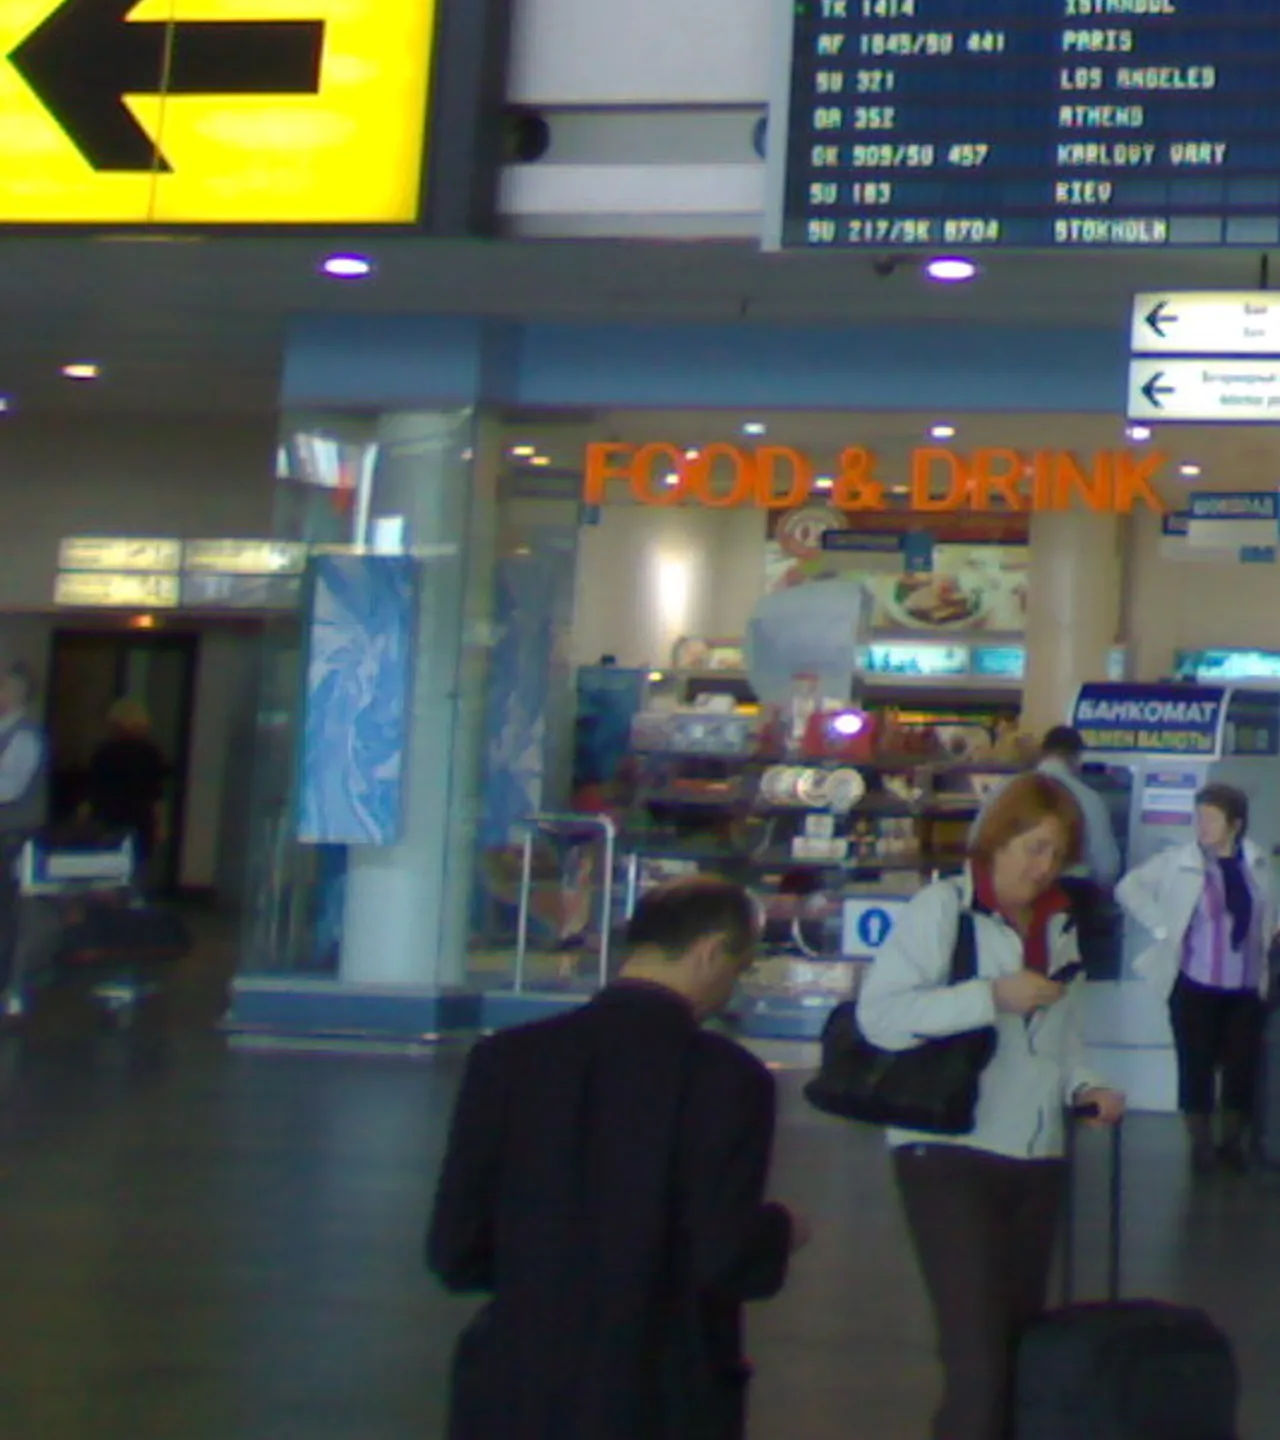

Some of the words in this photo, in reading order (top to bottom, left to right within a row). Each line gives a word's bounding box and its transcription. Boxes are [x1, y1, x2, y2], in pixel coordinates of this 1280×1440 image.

[1062, 29, 1133, 52] PARIS
[1060, 67, 1103, 90] LOS
[1057, 143, 1155, 167] KARLOVY
[583, 442, 809, 508] FOOD
[831, 446, 885, 510] &
[911, 448, 1169, 514] DRINK
[1076, 698, 1218, 722] БАНКОМАТ
